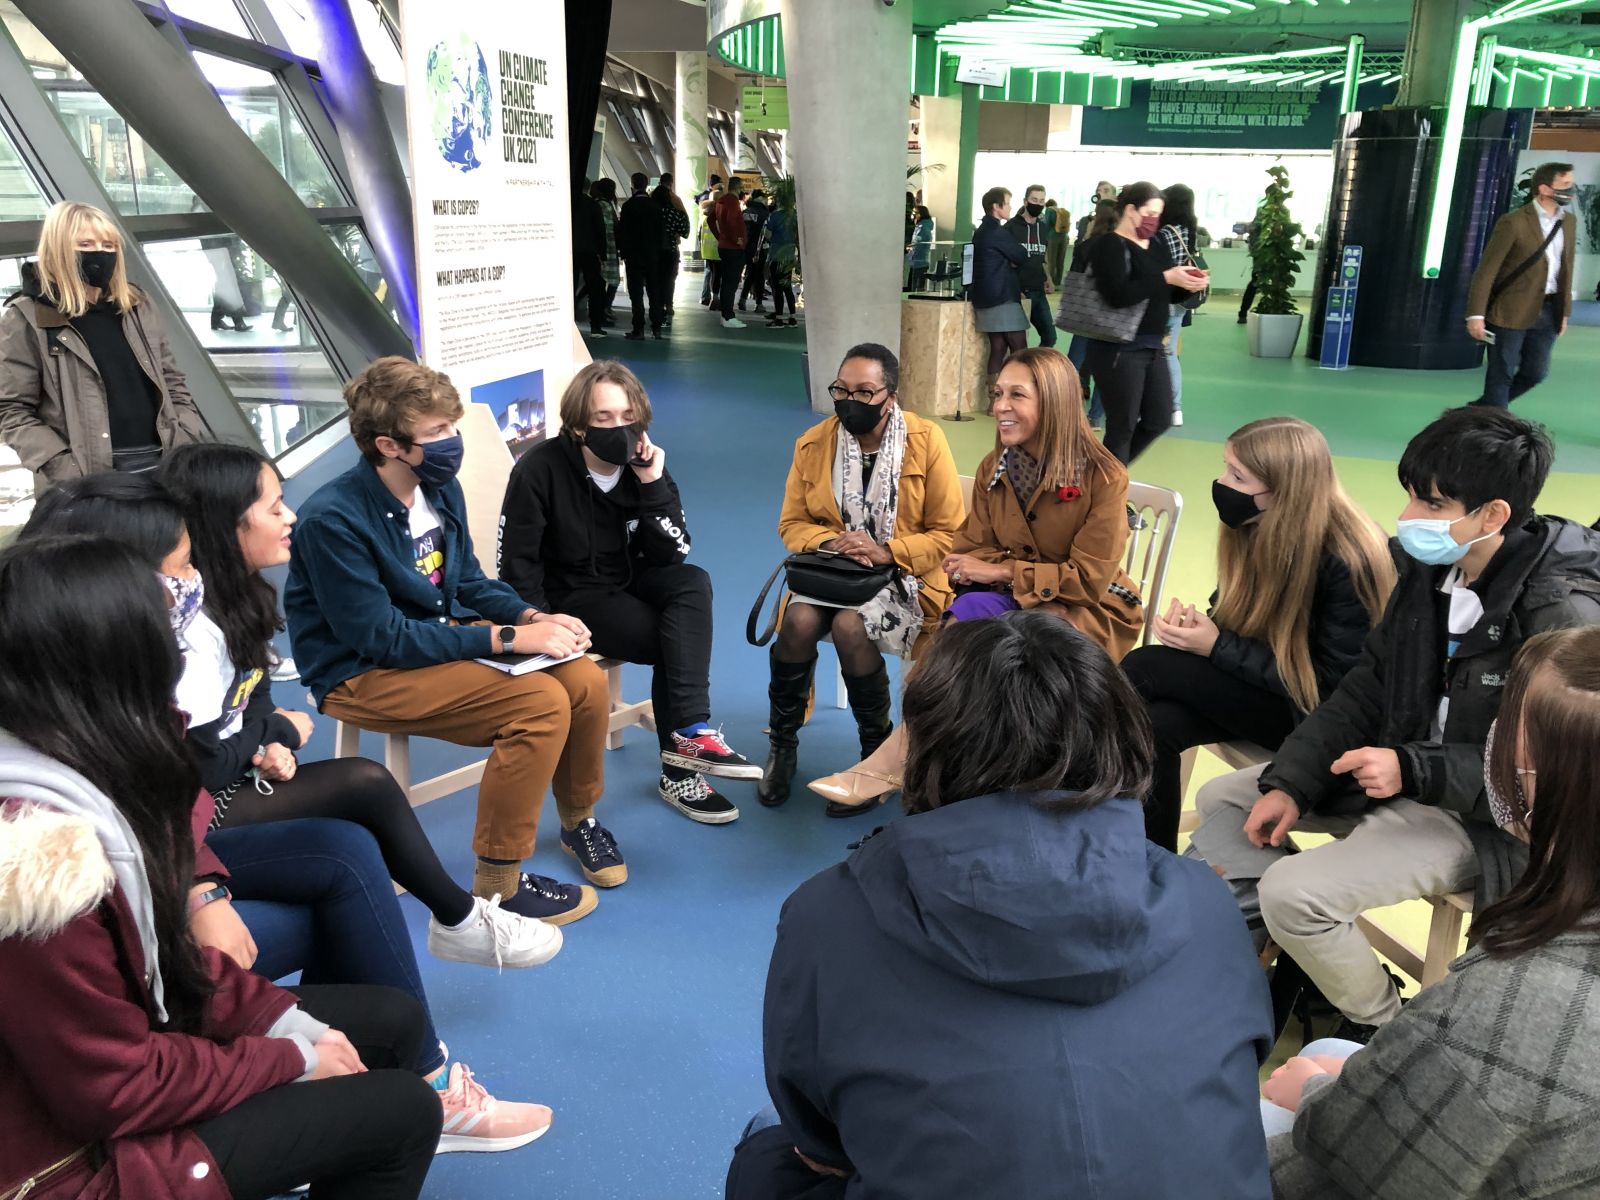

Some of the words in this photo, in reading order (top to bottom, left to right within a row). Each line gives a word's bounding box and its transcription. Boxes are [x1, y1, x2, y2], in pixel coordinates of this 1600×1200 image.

[499, 50, 512, 78] UN
[513, 53, 548, 85] CLIMATE
[500, 79, 536, 110] CHANGE
[1147, 113, 1160, 125] ALL
[1161, 113, 1174, 125] WE
[1202, 114, 1217, 126] THE
[1267, 115, 1278, 126] TO
[1161, 102, 1181, 113] HAVE
[1182, 102, 1196, 114] THE
[1196, 103, 1222, 114] SKILLS
[502, 108, 554, 139] CONFERENCE
[503, 136, 516, 162] UK
[517, 138, 537, 164] 2021
[432, 199, 450, 216] WHAT
[451, 200, 457, 216] IS
[436, 270, 453, 287] WHAT
[454, 267, 480, 286] HAPPENS
[480, 267, 487, 282] AT
